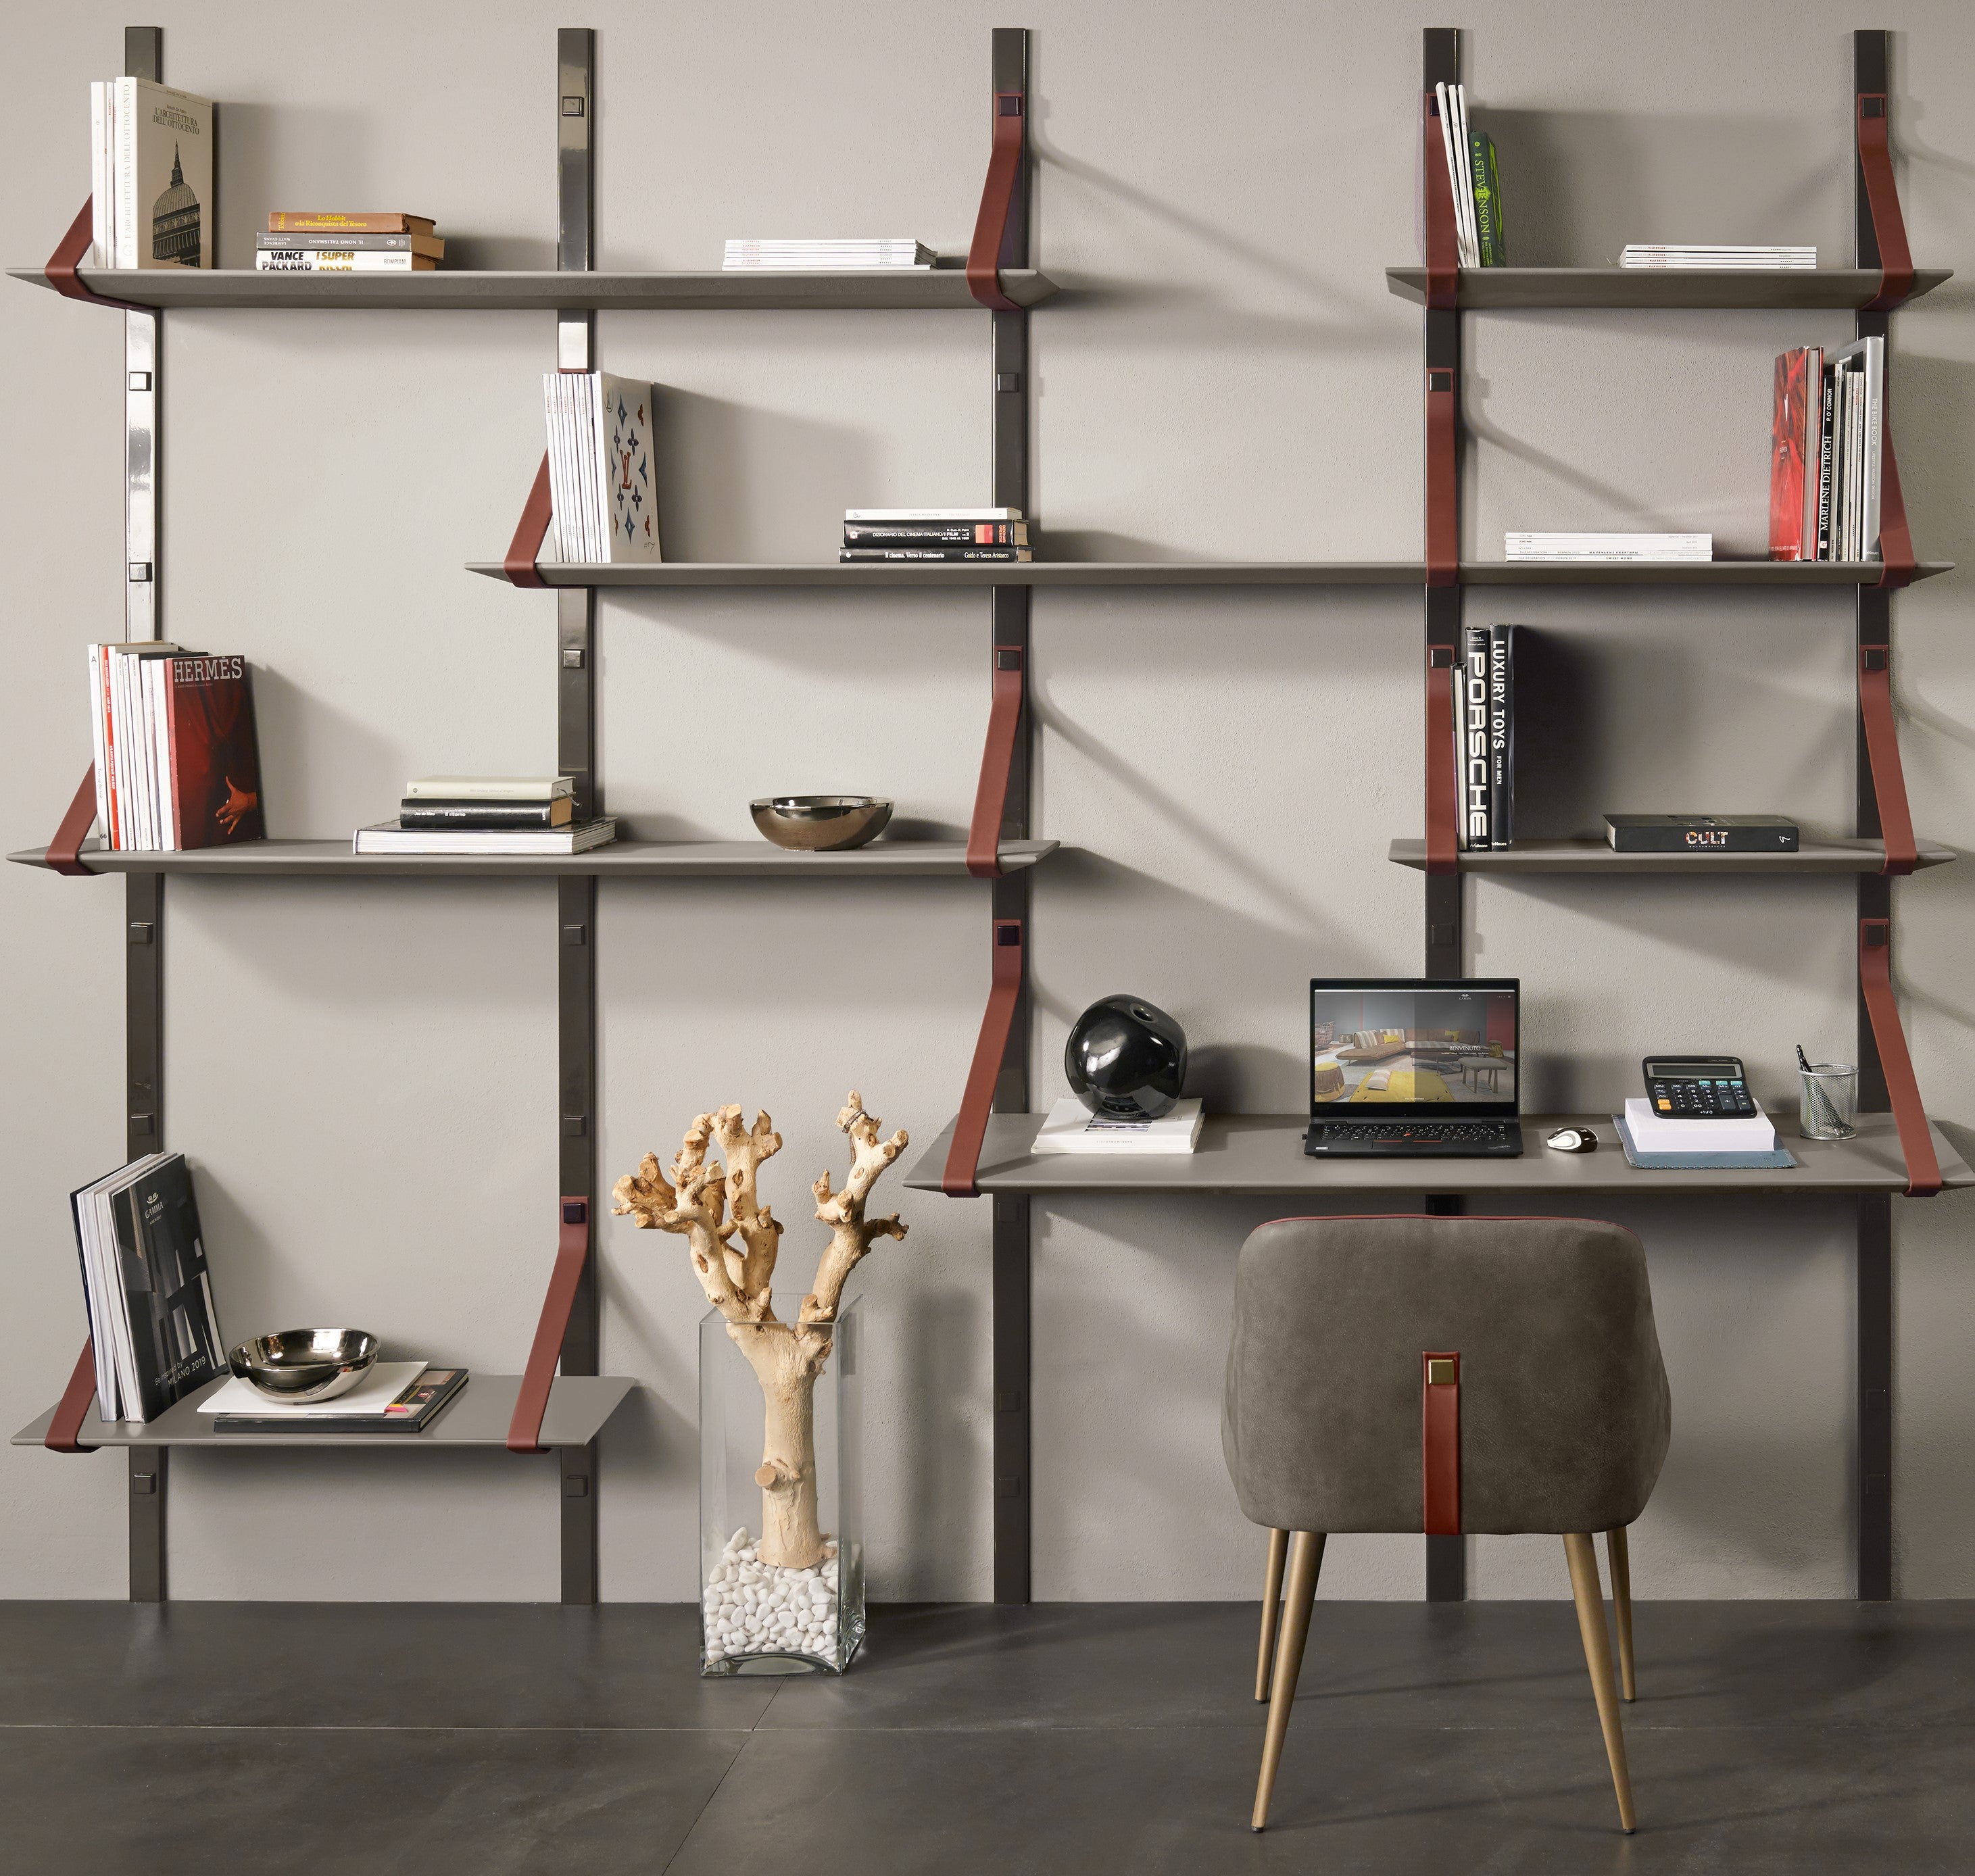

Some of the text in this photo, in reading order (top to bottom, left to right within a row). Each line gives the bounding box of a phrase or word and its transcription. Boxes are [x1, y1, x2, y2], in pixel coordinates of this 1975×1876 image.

[167, 119, 199, 135] OTTOCENTO
[1474, 159, 1490, 234] STEVENSON
[262, 261, 312, 270] PACKARD
[271, 251, 304, 261] VANCE
[316, 251, 356, 261] I SUPER
[1820, 436, 1832, 530] MARLENE DIETRICH
[173, 656, 243, 683] HERMÈS
[1492, 641, 1505, 704] LUXURY
[1492, 709, 1505, 749] TOYS
[1468, 651, 1487, 837] PORSCHE
[1685, 831, 1729, 845] CULT
[145, 1202, 164, 1219] GAMMA
[168, 1356, 206, 1386] MILANO 2019
